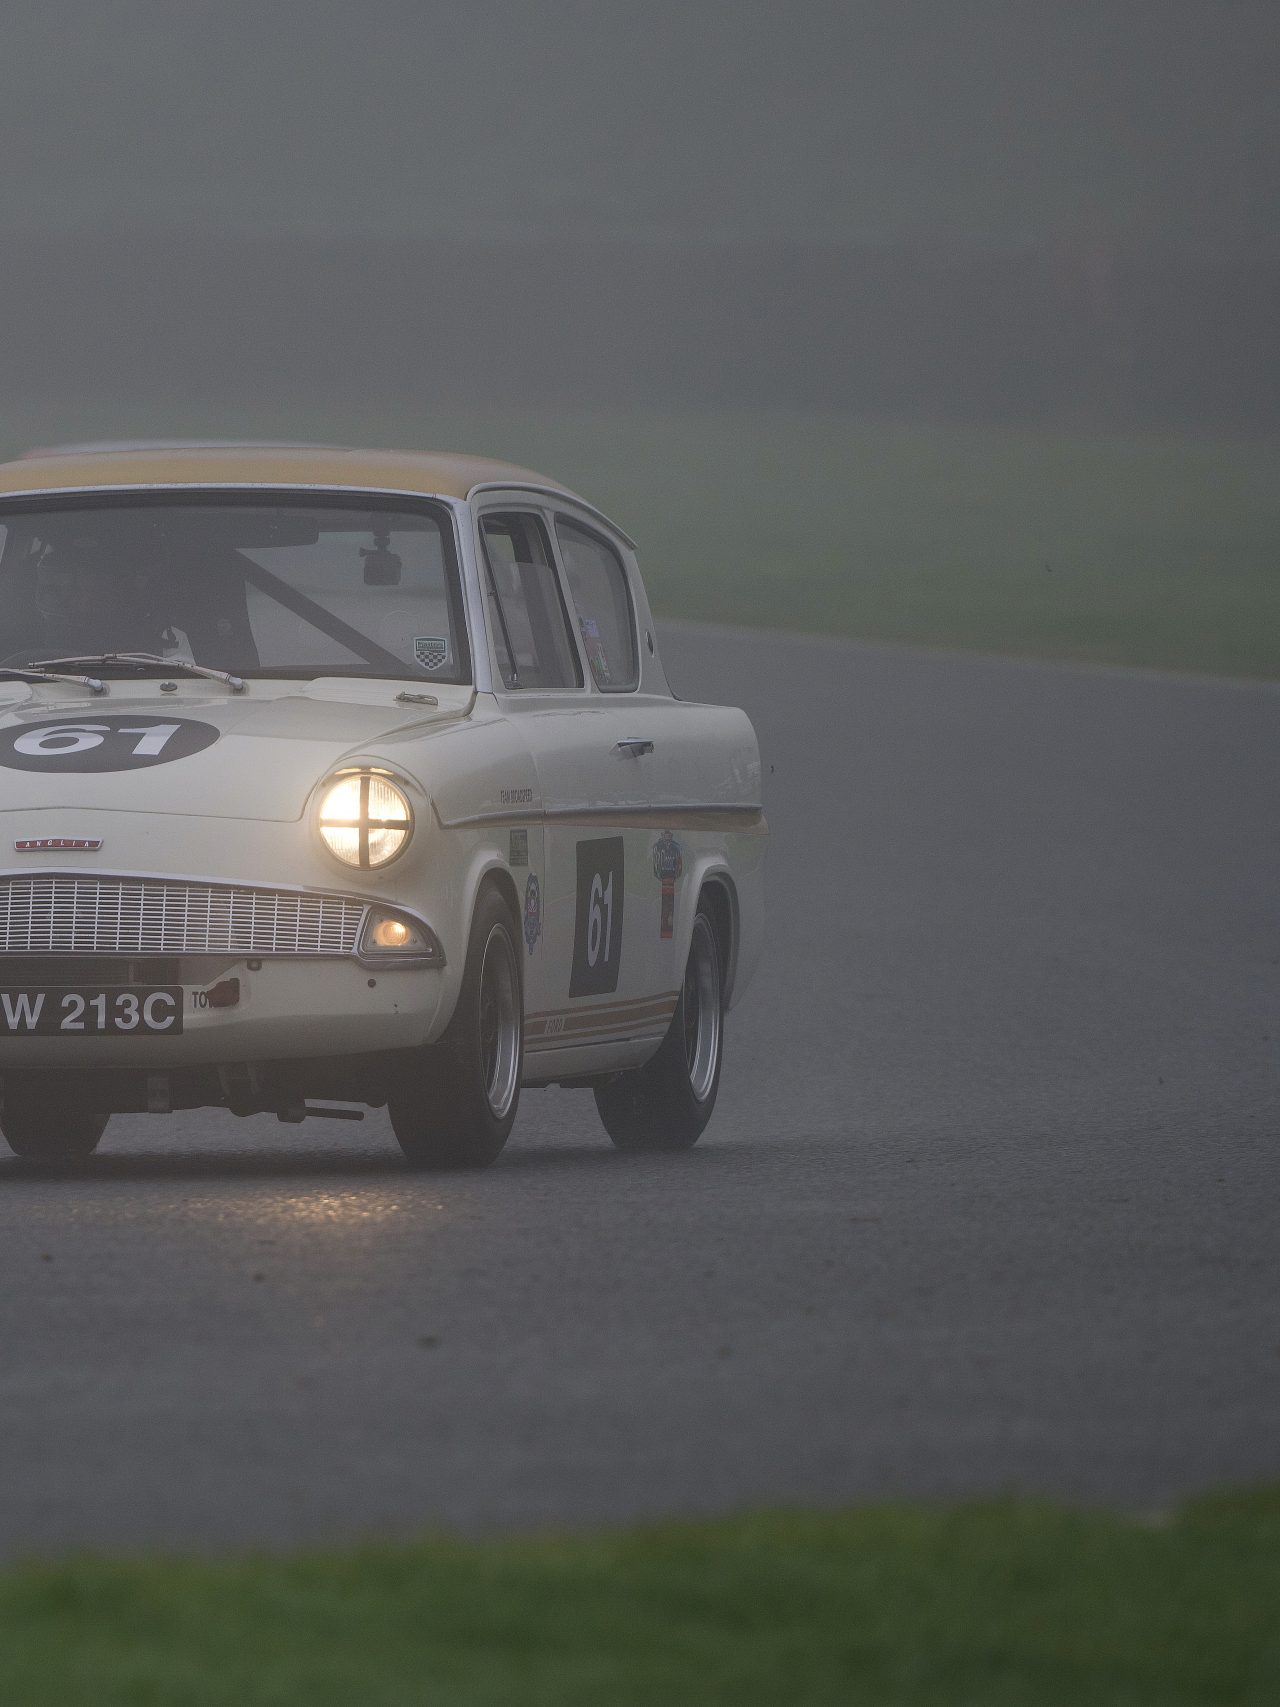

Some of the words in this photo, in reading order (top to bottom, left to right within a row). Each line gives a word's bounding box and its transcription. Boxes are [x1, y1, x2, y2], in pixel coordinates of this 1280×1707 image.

[12, 723, 182, 757] 61
[25, 839, 89, 848] ANGLIA
[587, 870, 615, 968] 61
[59, 992, 176, 1030] 213C
[192, 990, 213, 1008] TO
